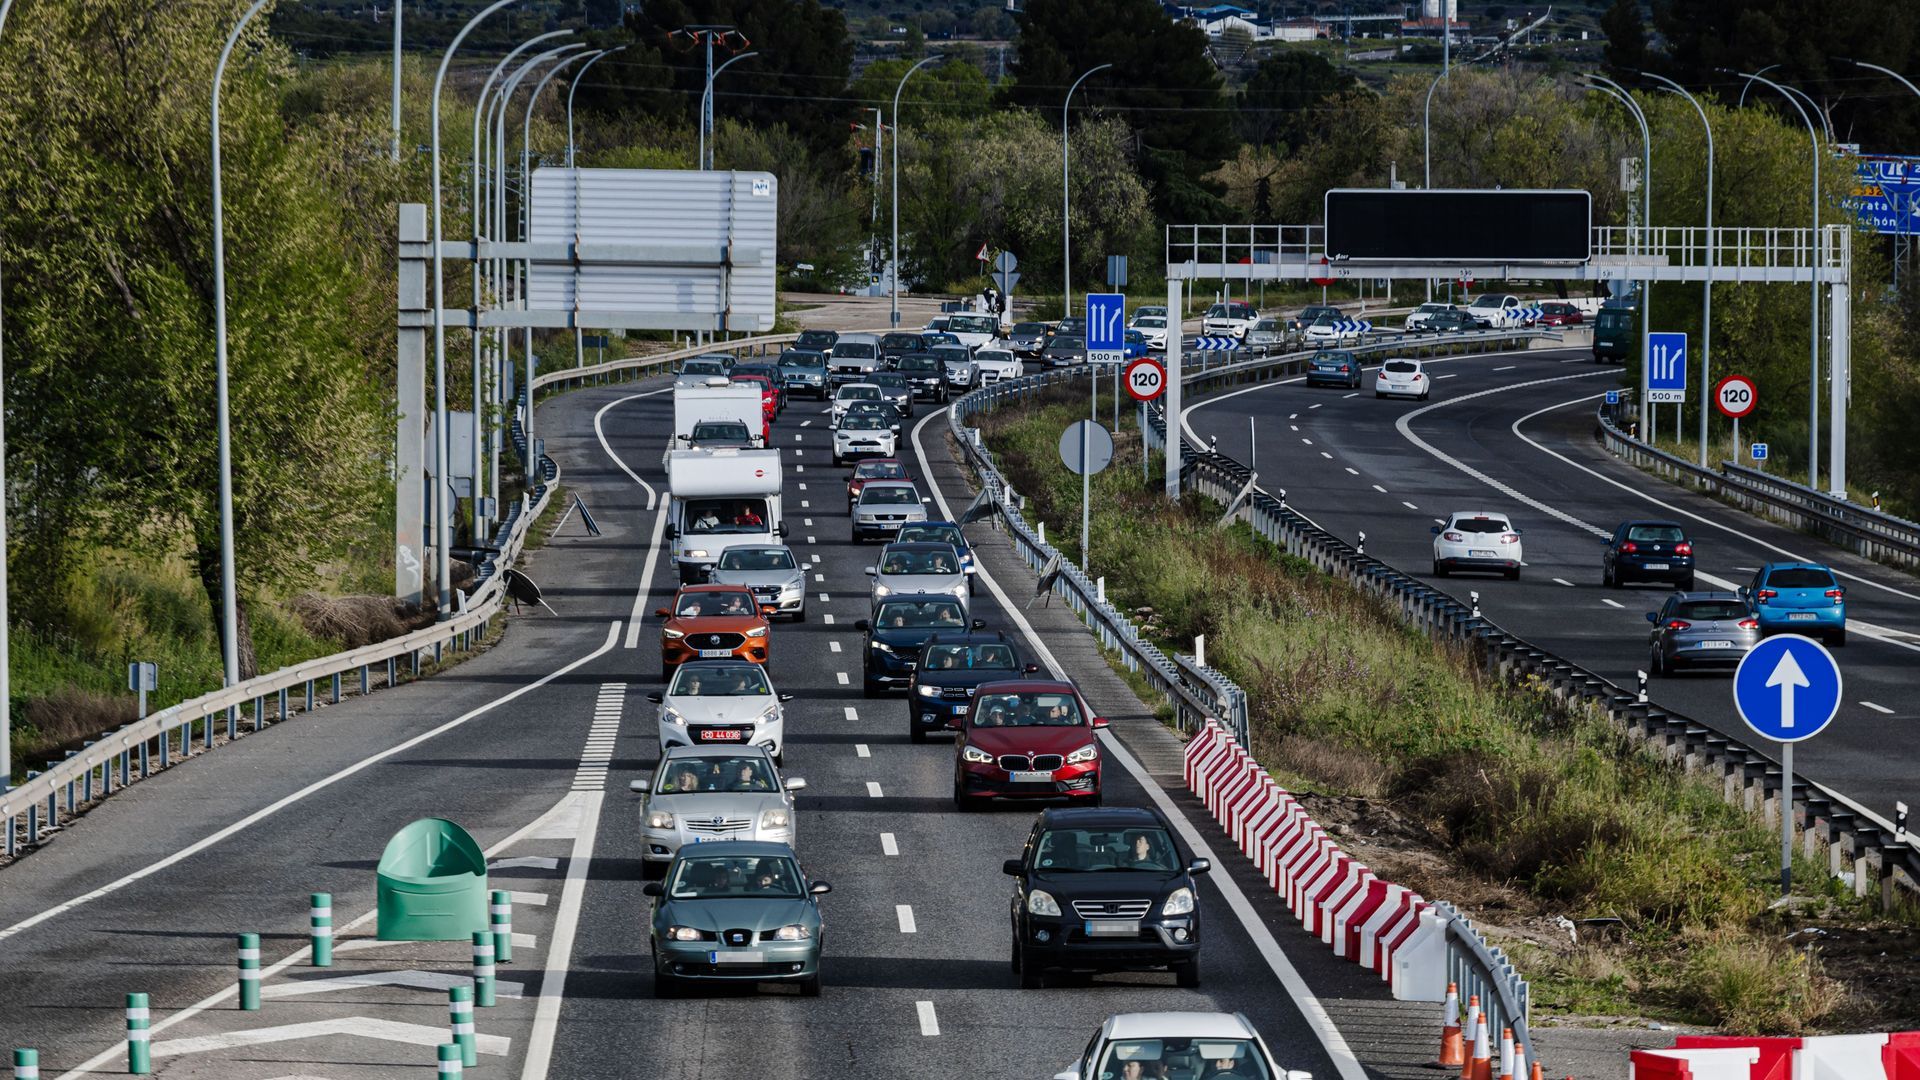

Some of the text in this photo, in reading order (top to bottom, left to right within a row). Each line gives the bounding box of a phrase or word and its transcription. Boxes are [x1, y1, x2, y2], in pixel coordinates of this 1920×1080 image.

[1091, 353, 1110, 361] 500
[1132, 373, 1159, 386] 120
[1652, 392, 1671, 400] 500
[1723, 389, 1749, 402] 120
